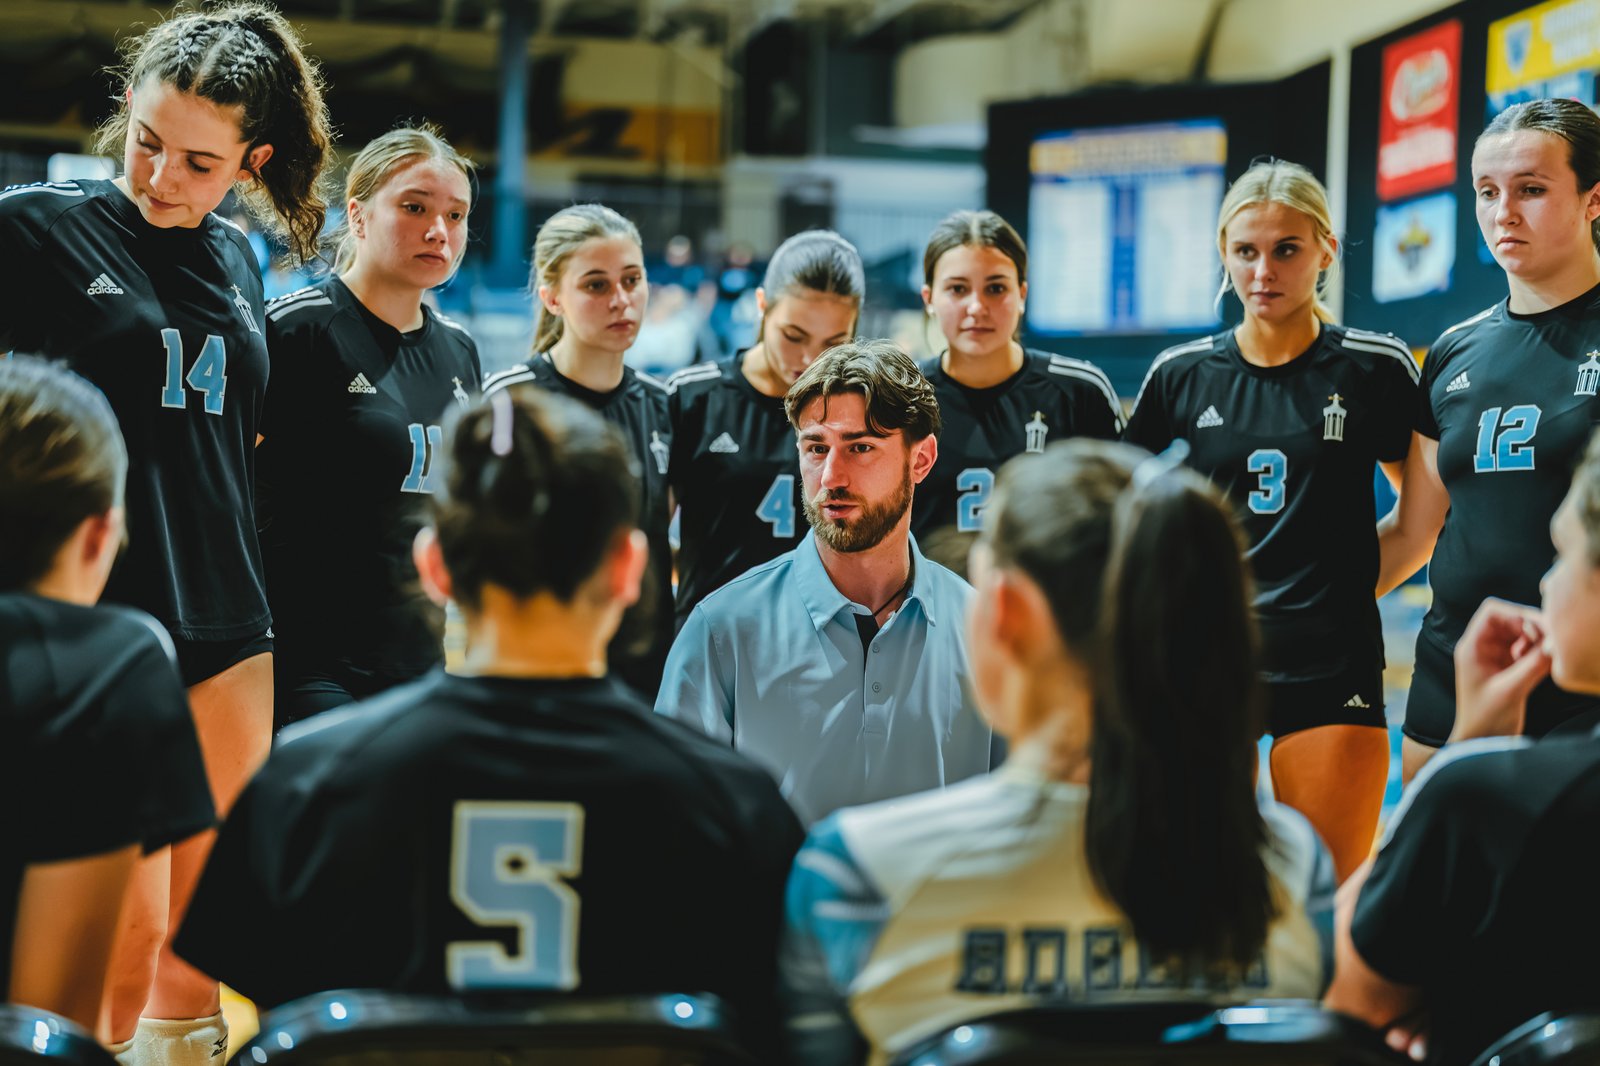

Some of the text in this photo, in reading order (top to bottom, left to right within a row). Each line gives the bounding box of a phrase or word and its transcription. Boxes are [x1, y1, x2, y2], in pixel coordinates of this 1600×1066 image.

[87, 285, 124, 295] adidas
[160, 327, 228, 416] 14
[400, 423, 443, 494] 11
[1473, 404, 1542, 473] 12
[755, 474, 796, 538] 4
[1247, 449, 1288, 514] 3
[446, 800, 586, 991] 5
